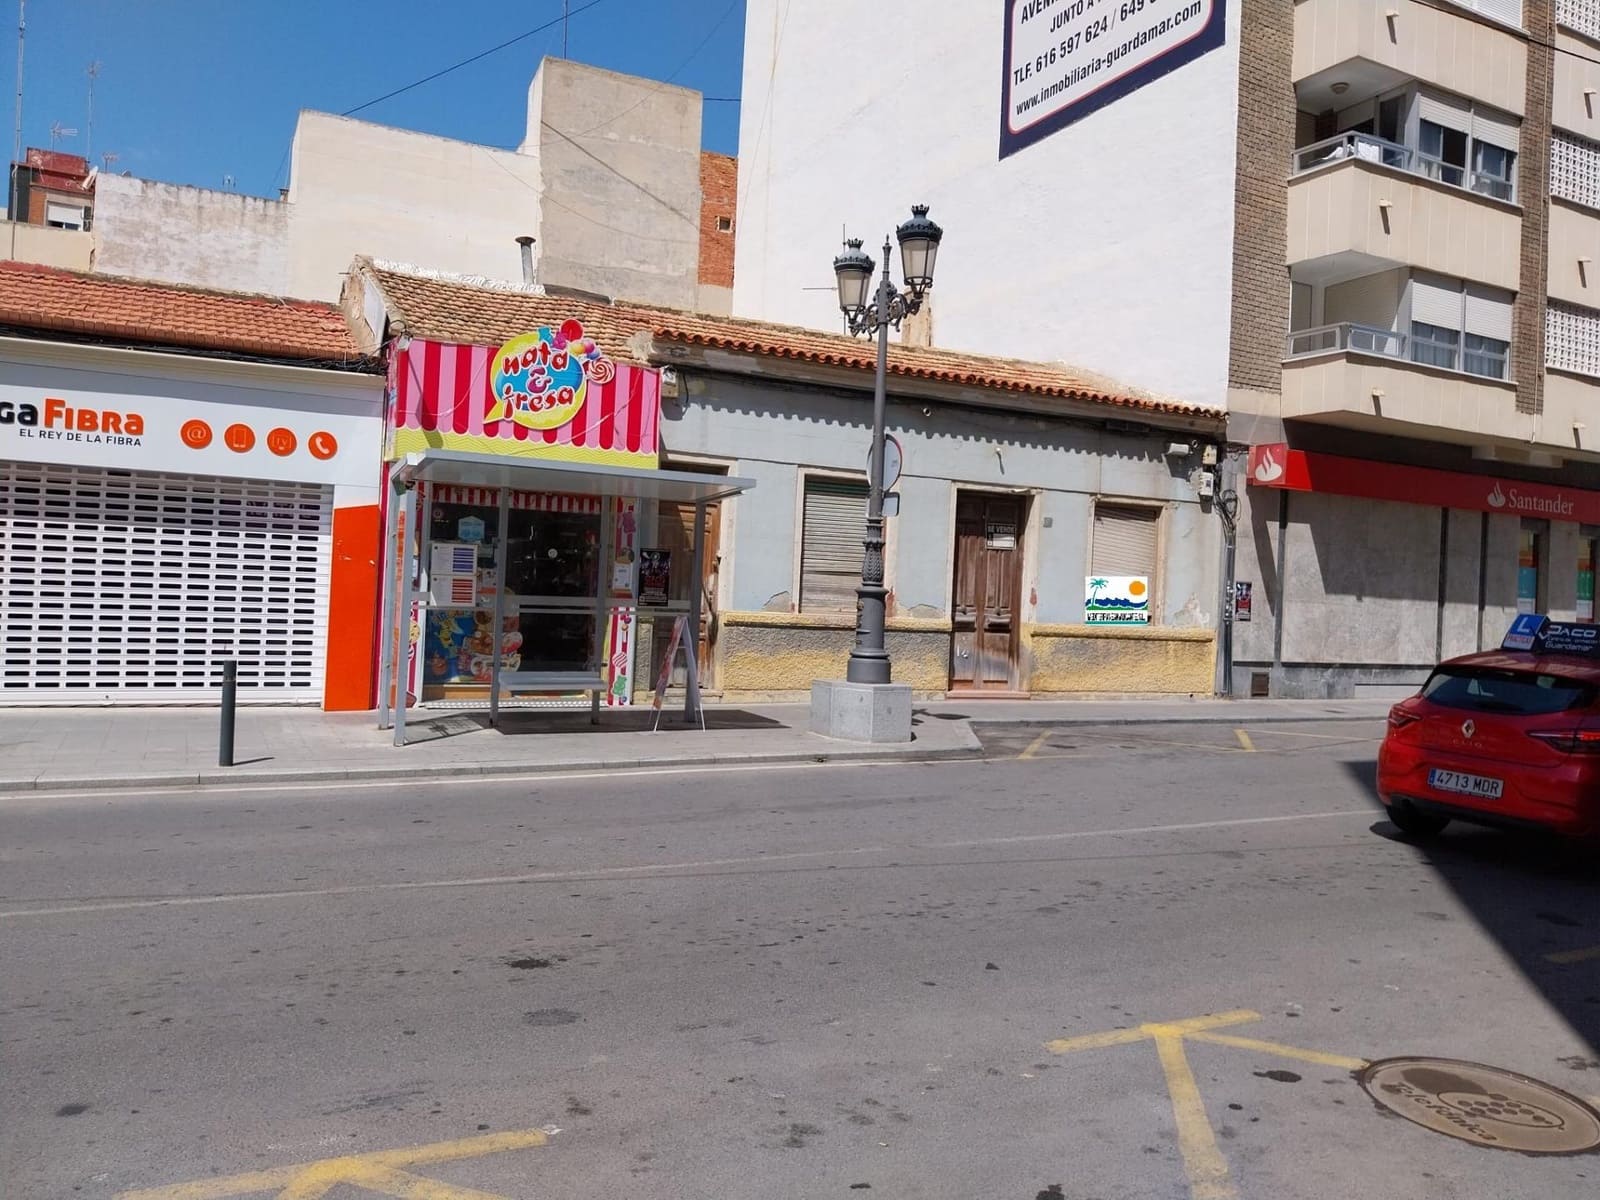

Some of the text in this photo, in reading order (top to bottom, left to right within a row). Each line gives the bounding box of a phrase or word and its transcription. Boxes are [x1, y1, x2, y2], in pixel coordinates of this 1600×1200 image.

[1050, 1, 1083, 33] JUNTO
[1014, 0, 1144, 86] TLF. 616 597 624 / 649
[1016, 0, 1201, 115] www.inmobiliaria-guardamar.com
[503, 341, 568, 375] nata
[503, 385, 574, 419] fresa
[19, 428, 142, 447] EL REY DE LA FIBRA
[1508, 488, 1574, 515] Santander
[1517, 616, 1530, 633] L
[1437, 771, 1499, 795] 4713 MDR
